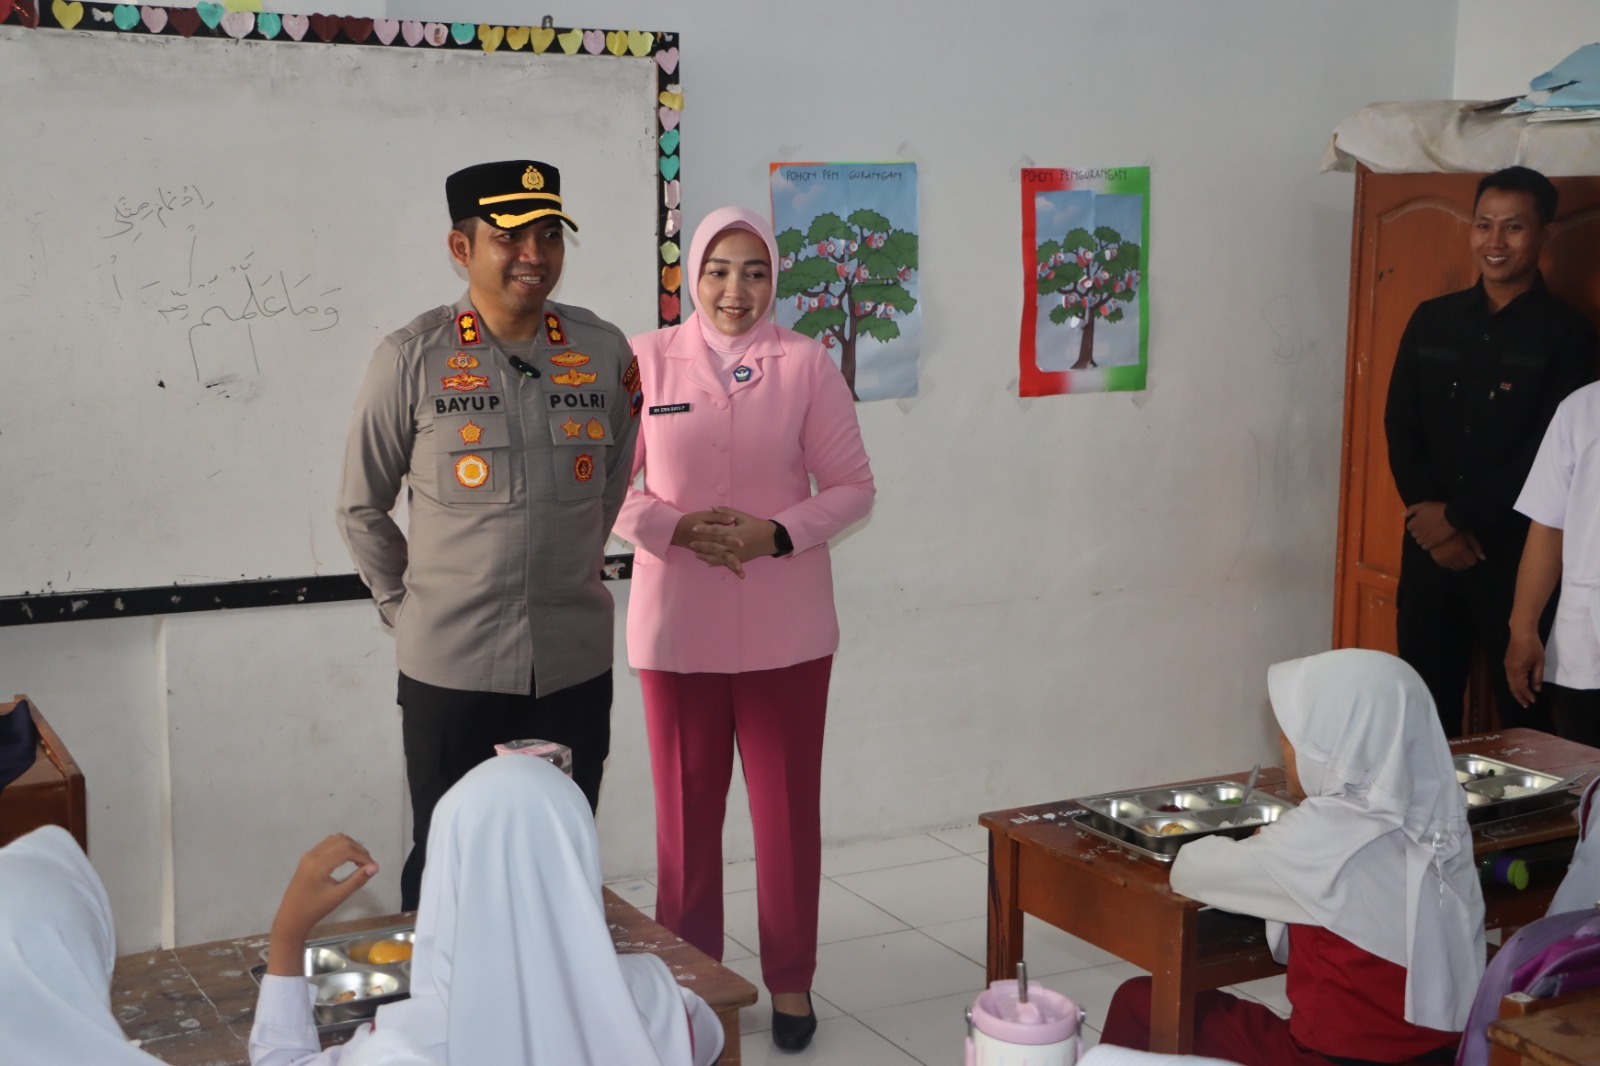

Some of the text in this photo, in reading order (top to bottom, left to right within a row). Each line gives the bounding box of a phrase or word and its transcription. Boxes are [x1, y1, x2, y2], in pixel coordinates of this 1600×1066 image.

[786, 169, 817, 183] POHON
[436, 398, 484, 414] BAYU
[550, 393, 605, 408] POLRI
